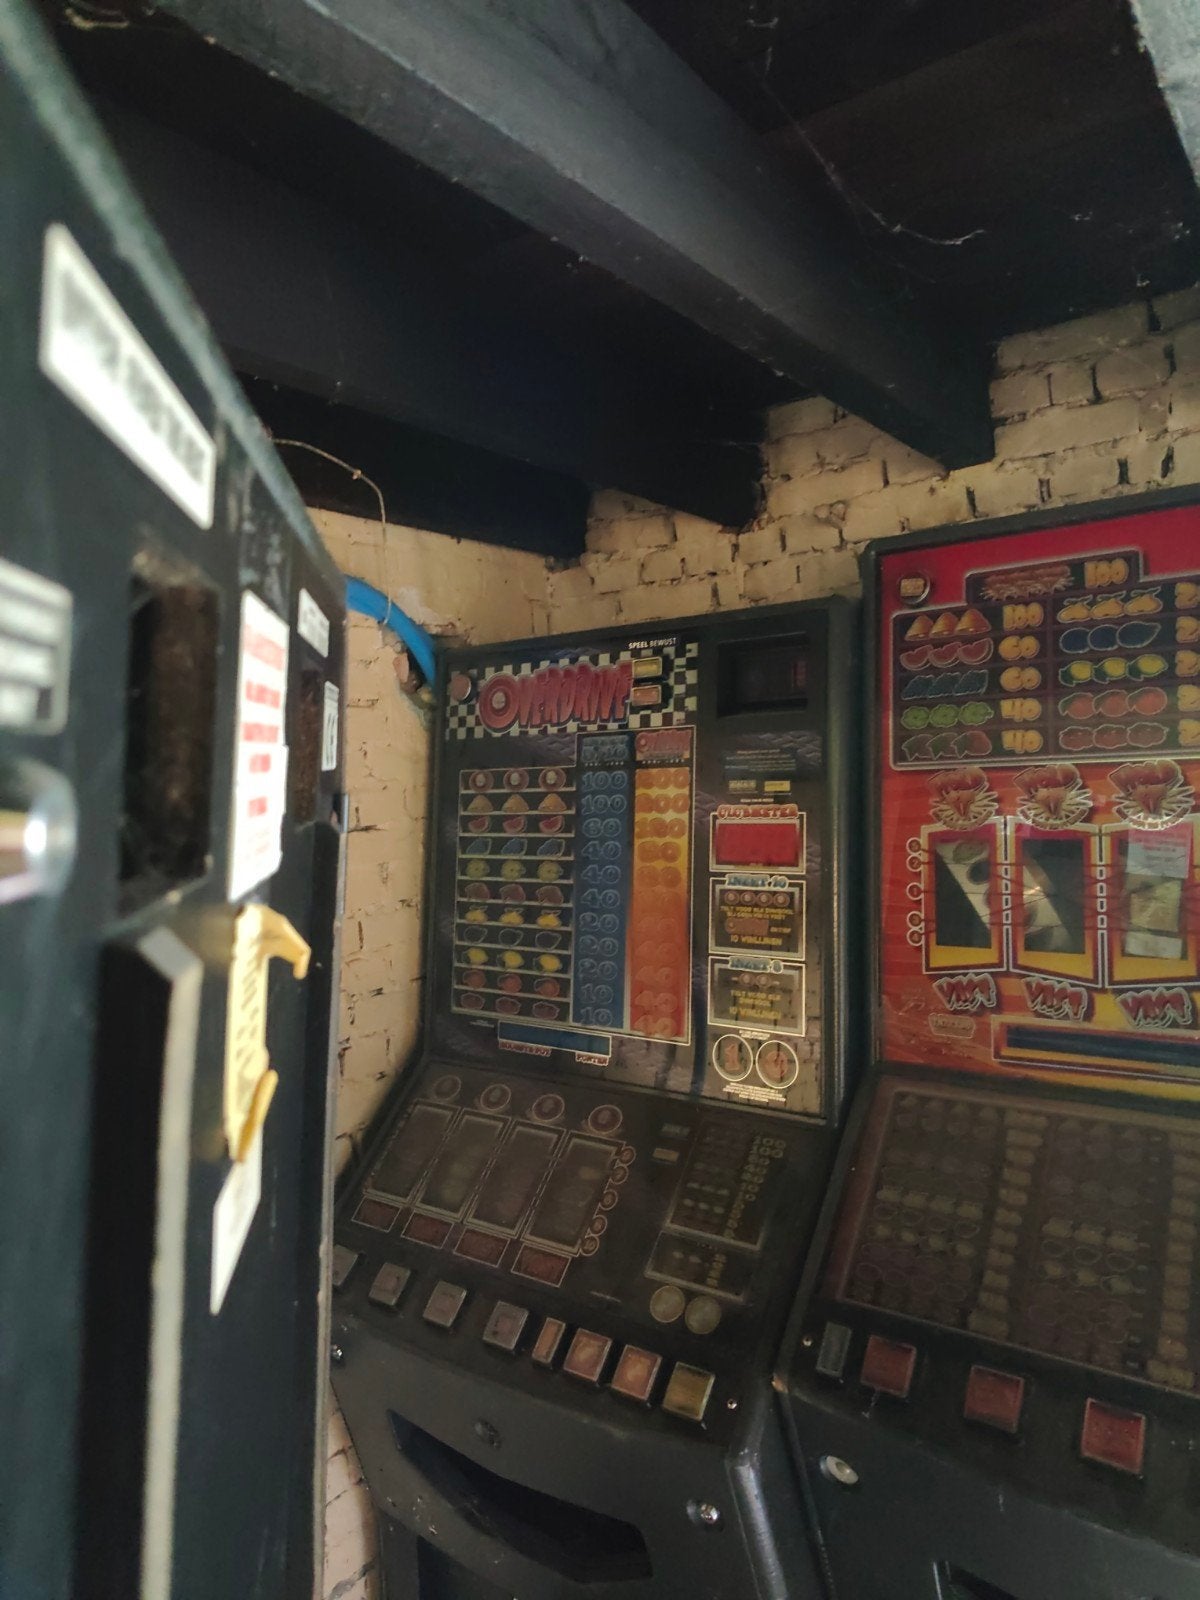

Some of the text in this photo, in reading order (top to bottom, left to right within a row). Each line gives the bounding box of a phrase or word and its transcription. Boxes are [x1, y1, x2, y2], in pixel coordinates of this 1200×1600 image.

[628, 637, 676, 650] SPEEL BEWUST
[582, 770, 628, 791] 100
[581, 794, 627, 815] 100
[581, 840, 622, 860] 40
[580, 864, 621, 884] 40
[580, 888, 620, 909] 40
